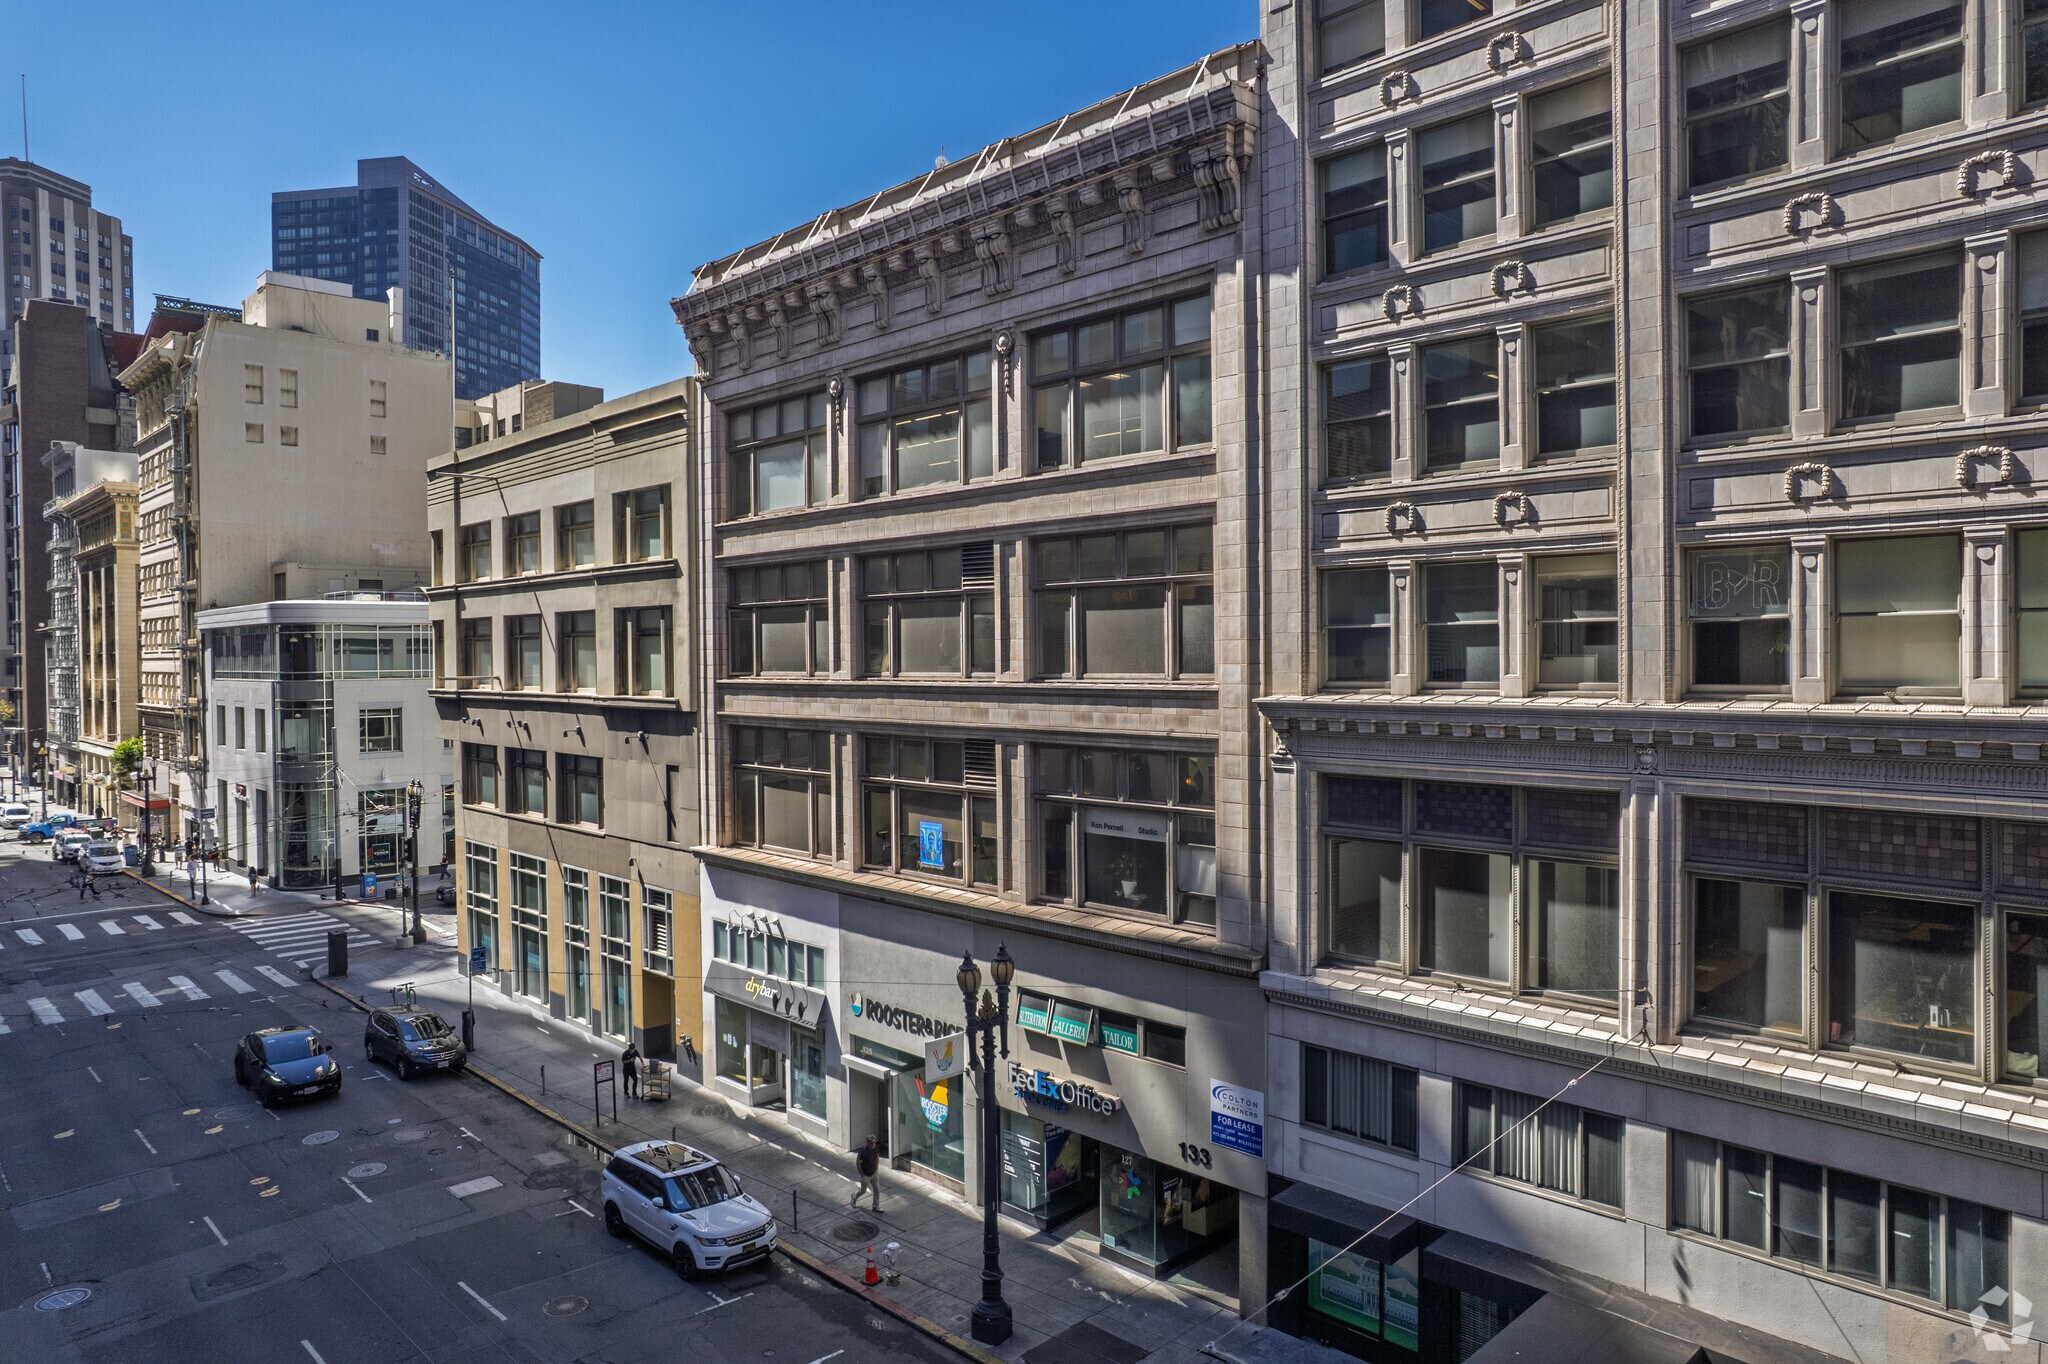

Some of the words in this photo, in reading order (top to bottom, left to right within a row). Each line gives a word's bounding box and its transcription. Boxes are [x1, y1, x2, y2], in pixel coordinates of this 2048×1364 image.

[1091, 821, 1103, 829] Ron
[1138, 827, 1158, 836] Studio
[745, 976, 778, 1000] drybar
[1052, 1020, 1085, 1040] GALLERIA
[1103, 1030, 1133, 1050] TAILOR
[1008, 1061, 1060, 1099] FedEx
[1061, 1081, 1113, 1116] Office
[921, 1098, 948, 1115] ROOSTER
[1222, 1093, 1258, 1109] COLTON
[1223, 1104, 1258, 1119] PARTNERS
[1217, 1115, 1232, 1126] FOR
[1233, 1120, 1256, 1133] LEASE
[1121, 1154, 1132, 1165] 127
[1179, 1142, 1212, 1170] 133
